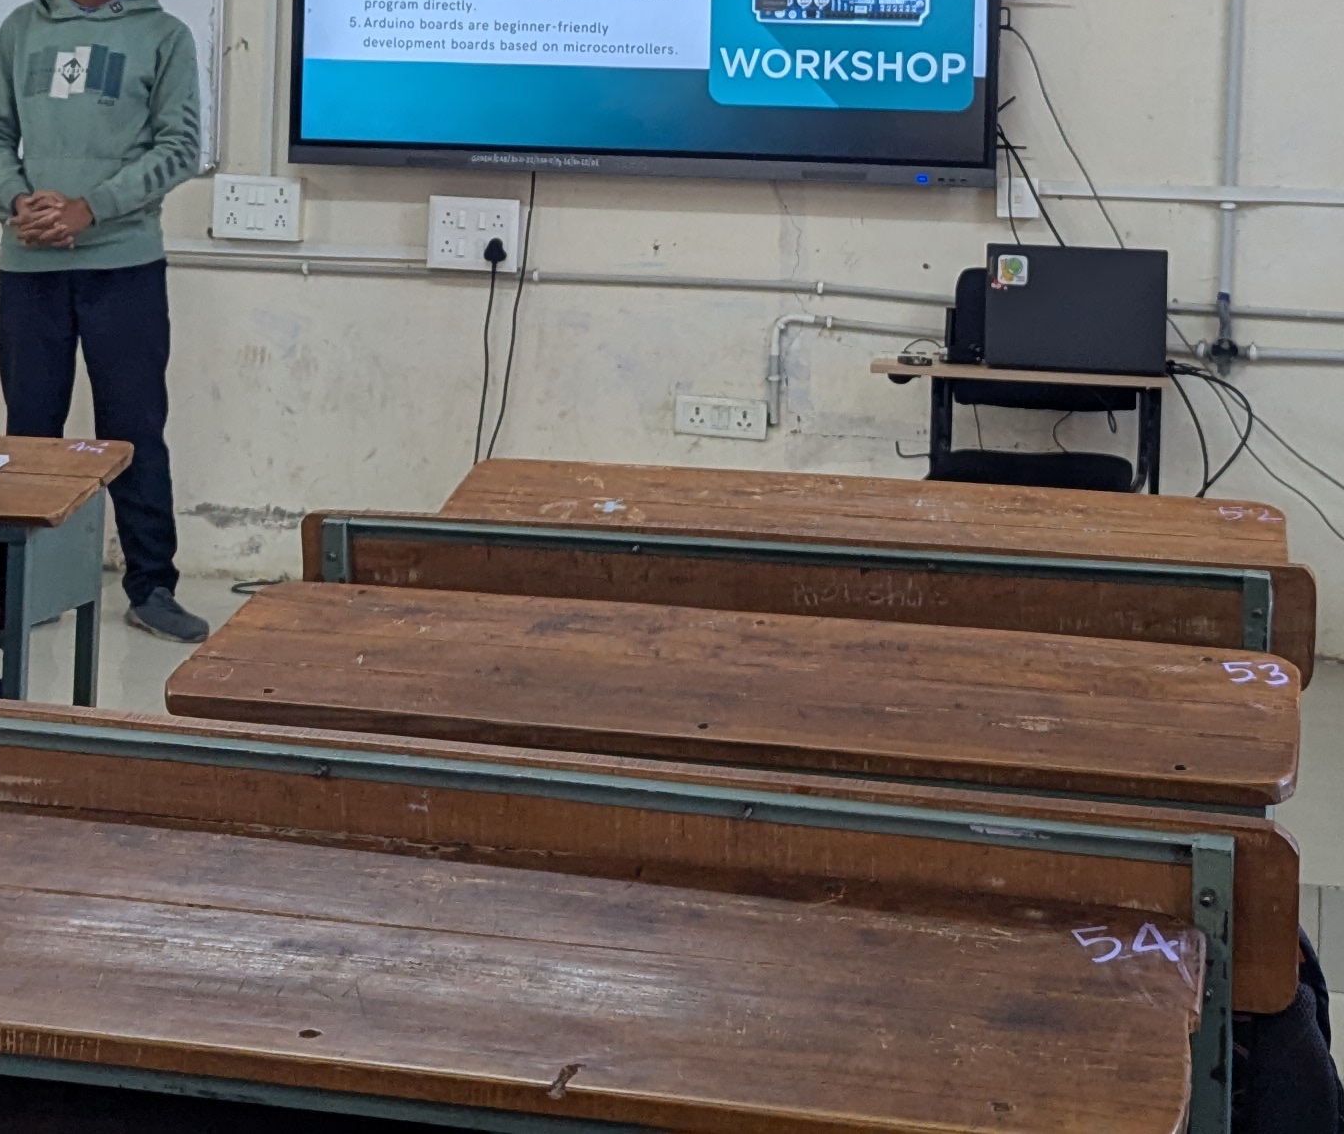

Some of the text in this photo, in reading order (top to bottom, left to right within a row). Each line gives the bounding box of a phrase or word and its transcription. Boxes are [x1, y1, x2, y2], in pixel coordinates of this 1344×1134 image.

[364, 0, 419, 13] program
[349, 16, 609, 37] 5. Arduino boards are beginner-friendly
[362, 35, 679, 56] development boards based on microcontrollers.
[719, 47, 967, 83] WORKSHOP
[1218, 506, 1283, 522] 52
[1221, 661, 1291, 686] 53
[1070, 922, 1180, 963] 54
